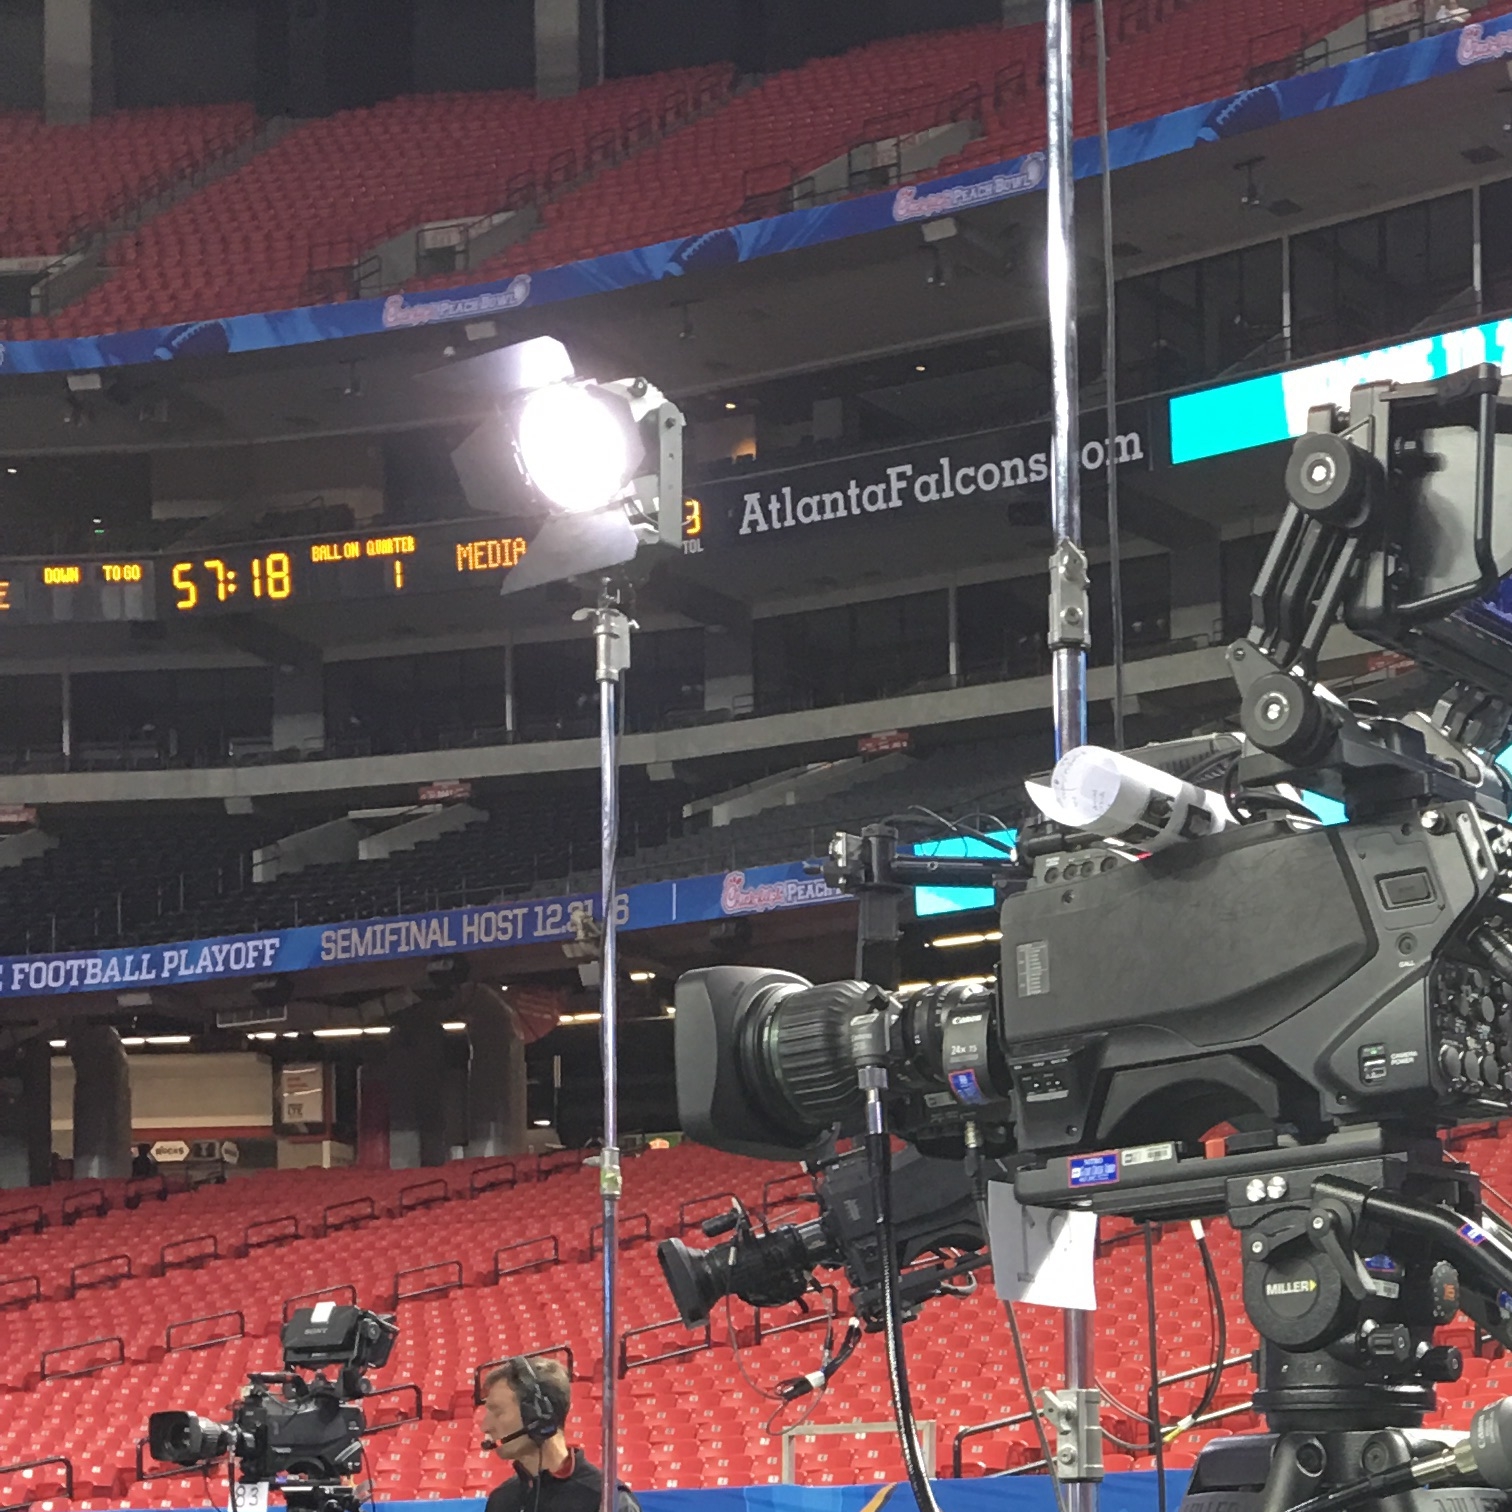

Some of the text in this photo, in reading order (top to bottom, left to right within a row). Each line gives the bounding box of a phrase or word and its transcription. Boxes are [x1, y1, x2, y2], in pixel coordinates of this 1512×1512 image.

[739, 431, 1143, 535] AtlantaFalconsom
[44, 566, 80, 584] DOWN
[172, 552, 291, 610] 57:18
[320, 916, 457, 961] SEMIFINAL
[462, 907, 529, 945] HOST
[11, 952, 156, 990] FOOTBALL
[161, 937, 280, 978] PLAYOFF
[1266, 1280, 1310, 1296] MILLER
